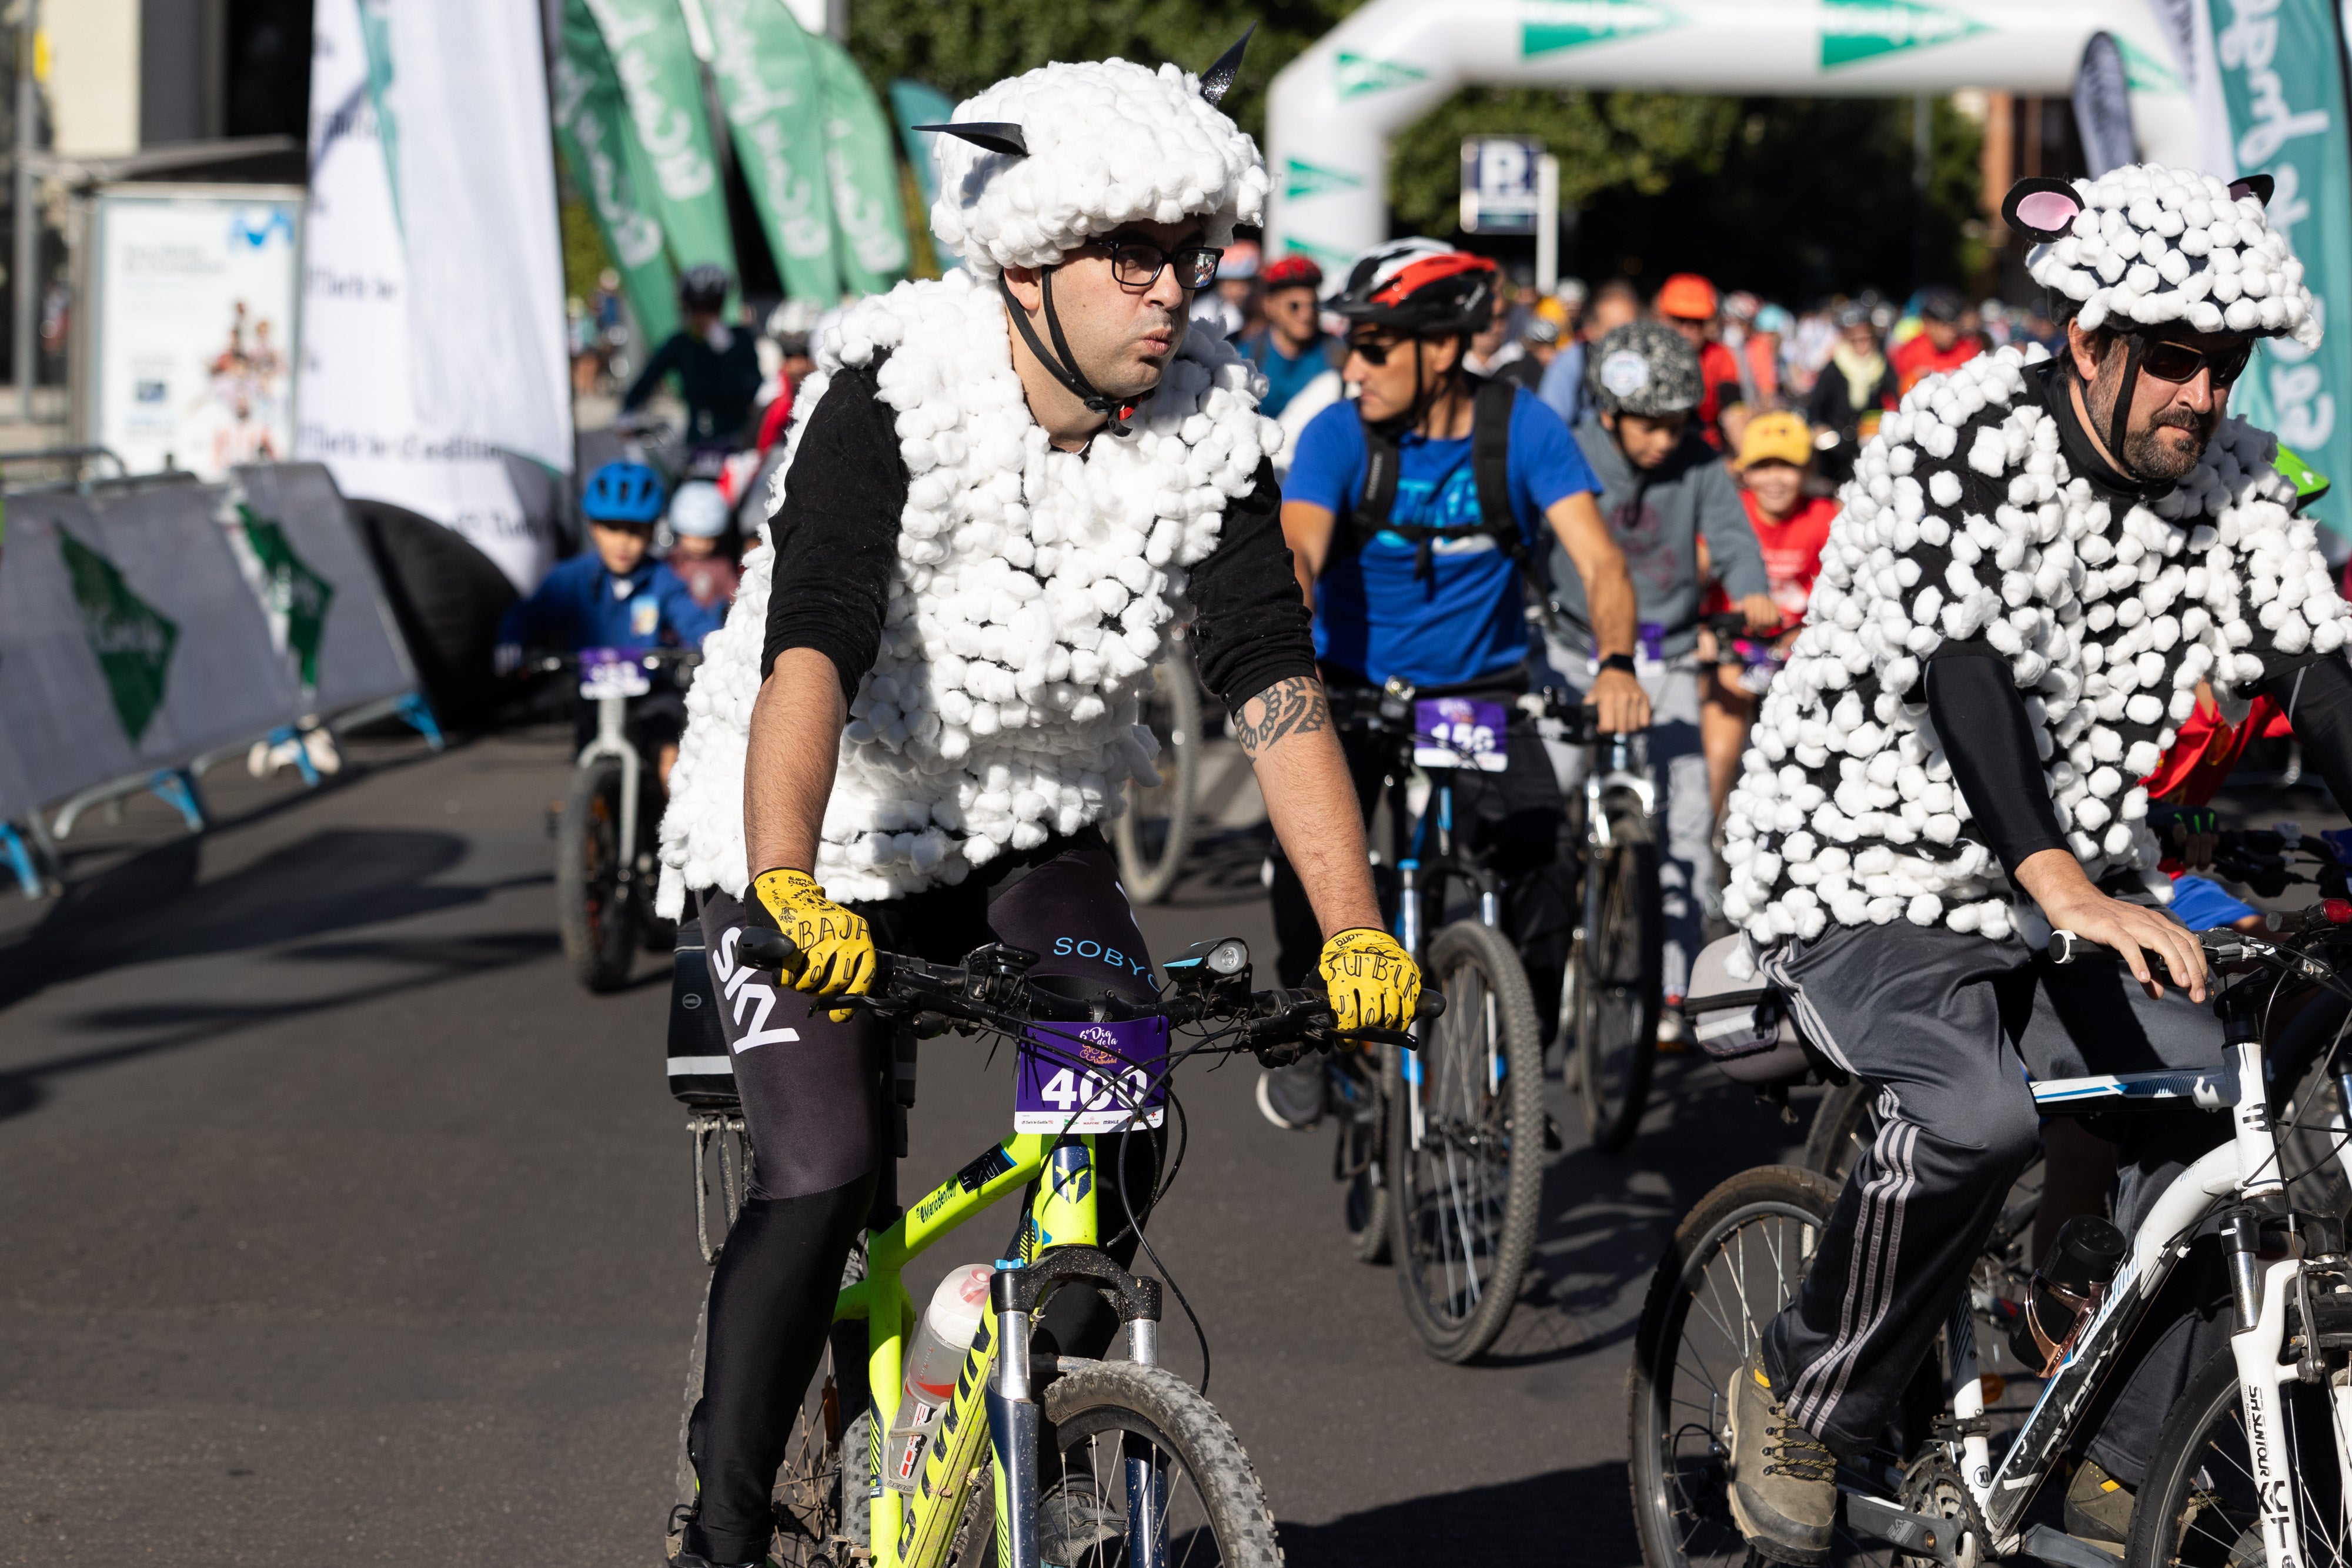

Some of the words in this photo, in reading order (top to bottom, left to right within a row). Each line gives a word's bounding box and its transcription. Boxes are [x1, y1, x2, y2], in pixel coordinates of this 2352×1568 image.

[1480, 140, 1527, 197] P
[799, 915, 871, 951] BAJA
[1329, 955, 1417, 1002] SUBIR
[1041, 1064, 1148, 1110] 400
[887, 1480, 913, 1492] BERG
